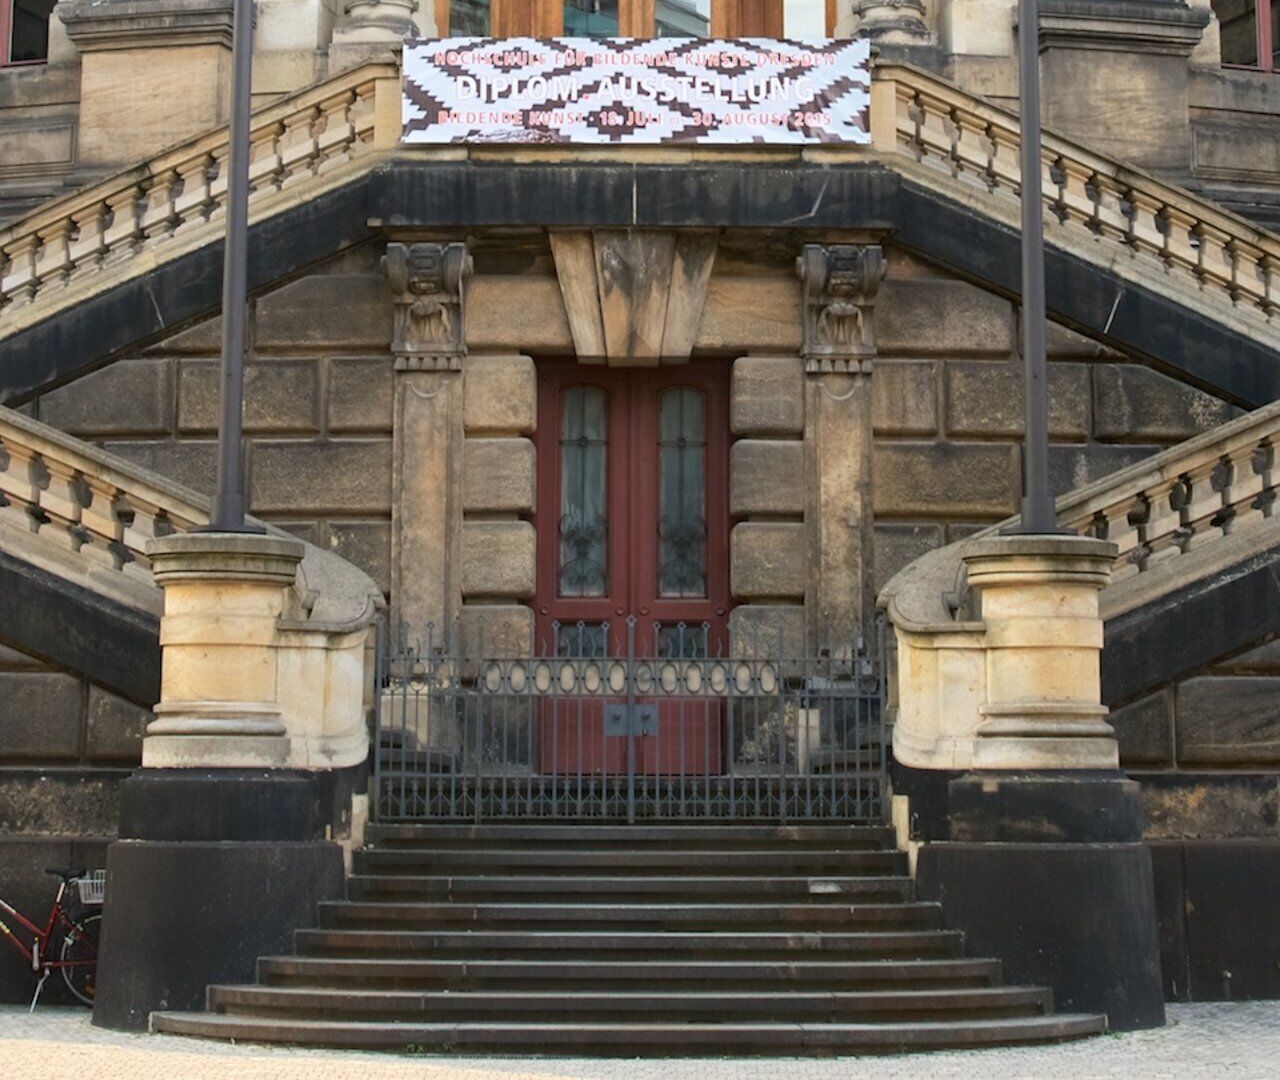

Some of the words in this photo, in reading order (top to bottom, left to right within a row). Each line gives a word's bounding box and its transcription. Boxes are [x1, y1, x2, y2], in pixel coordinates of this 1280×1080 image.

[434, 51, 546, 66] HOCHSCHULE
[555, 50, 587, 66] FÜR
[593, 52, 677, 66] BILDENDE
[756, 52, 836, 67] DRESDEN
[437, 110, 523, 125] BILDENDE
[722, 111, 788, 126] AUGUST
